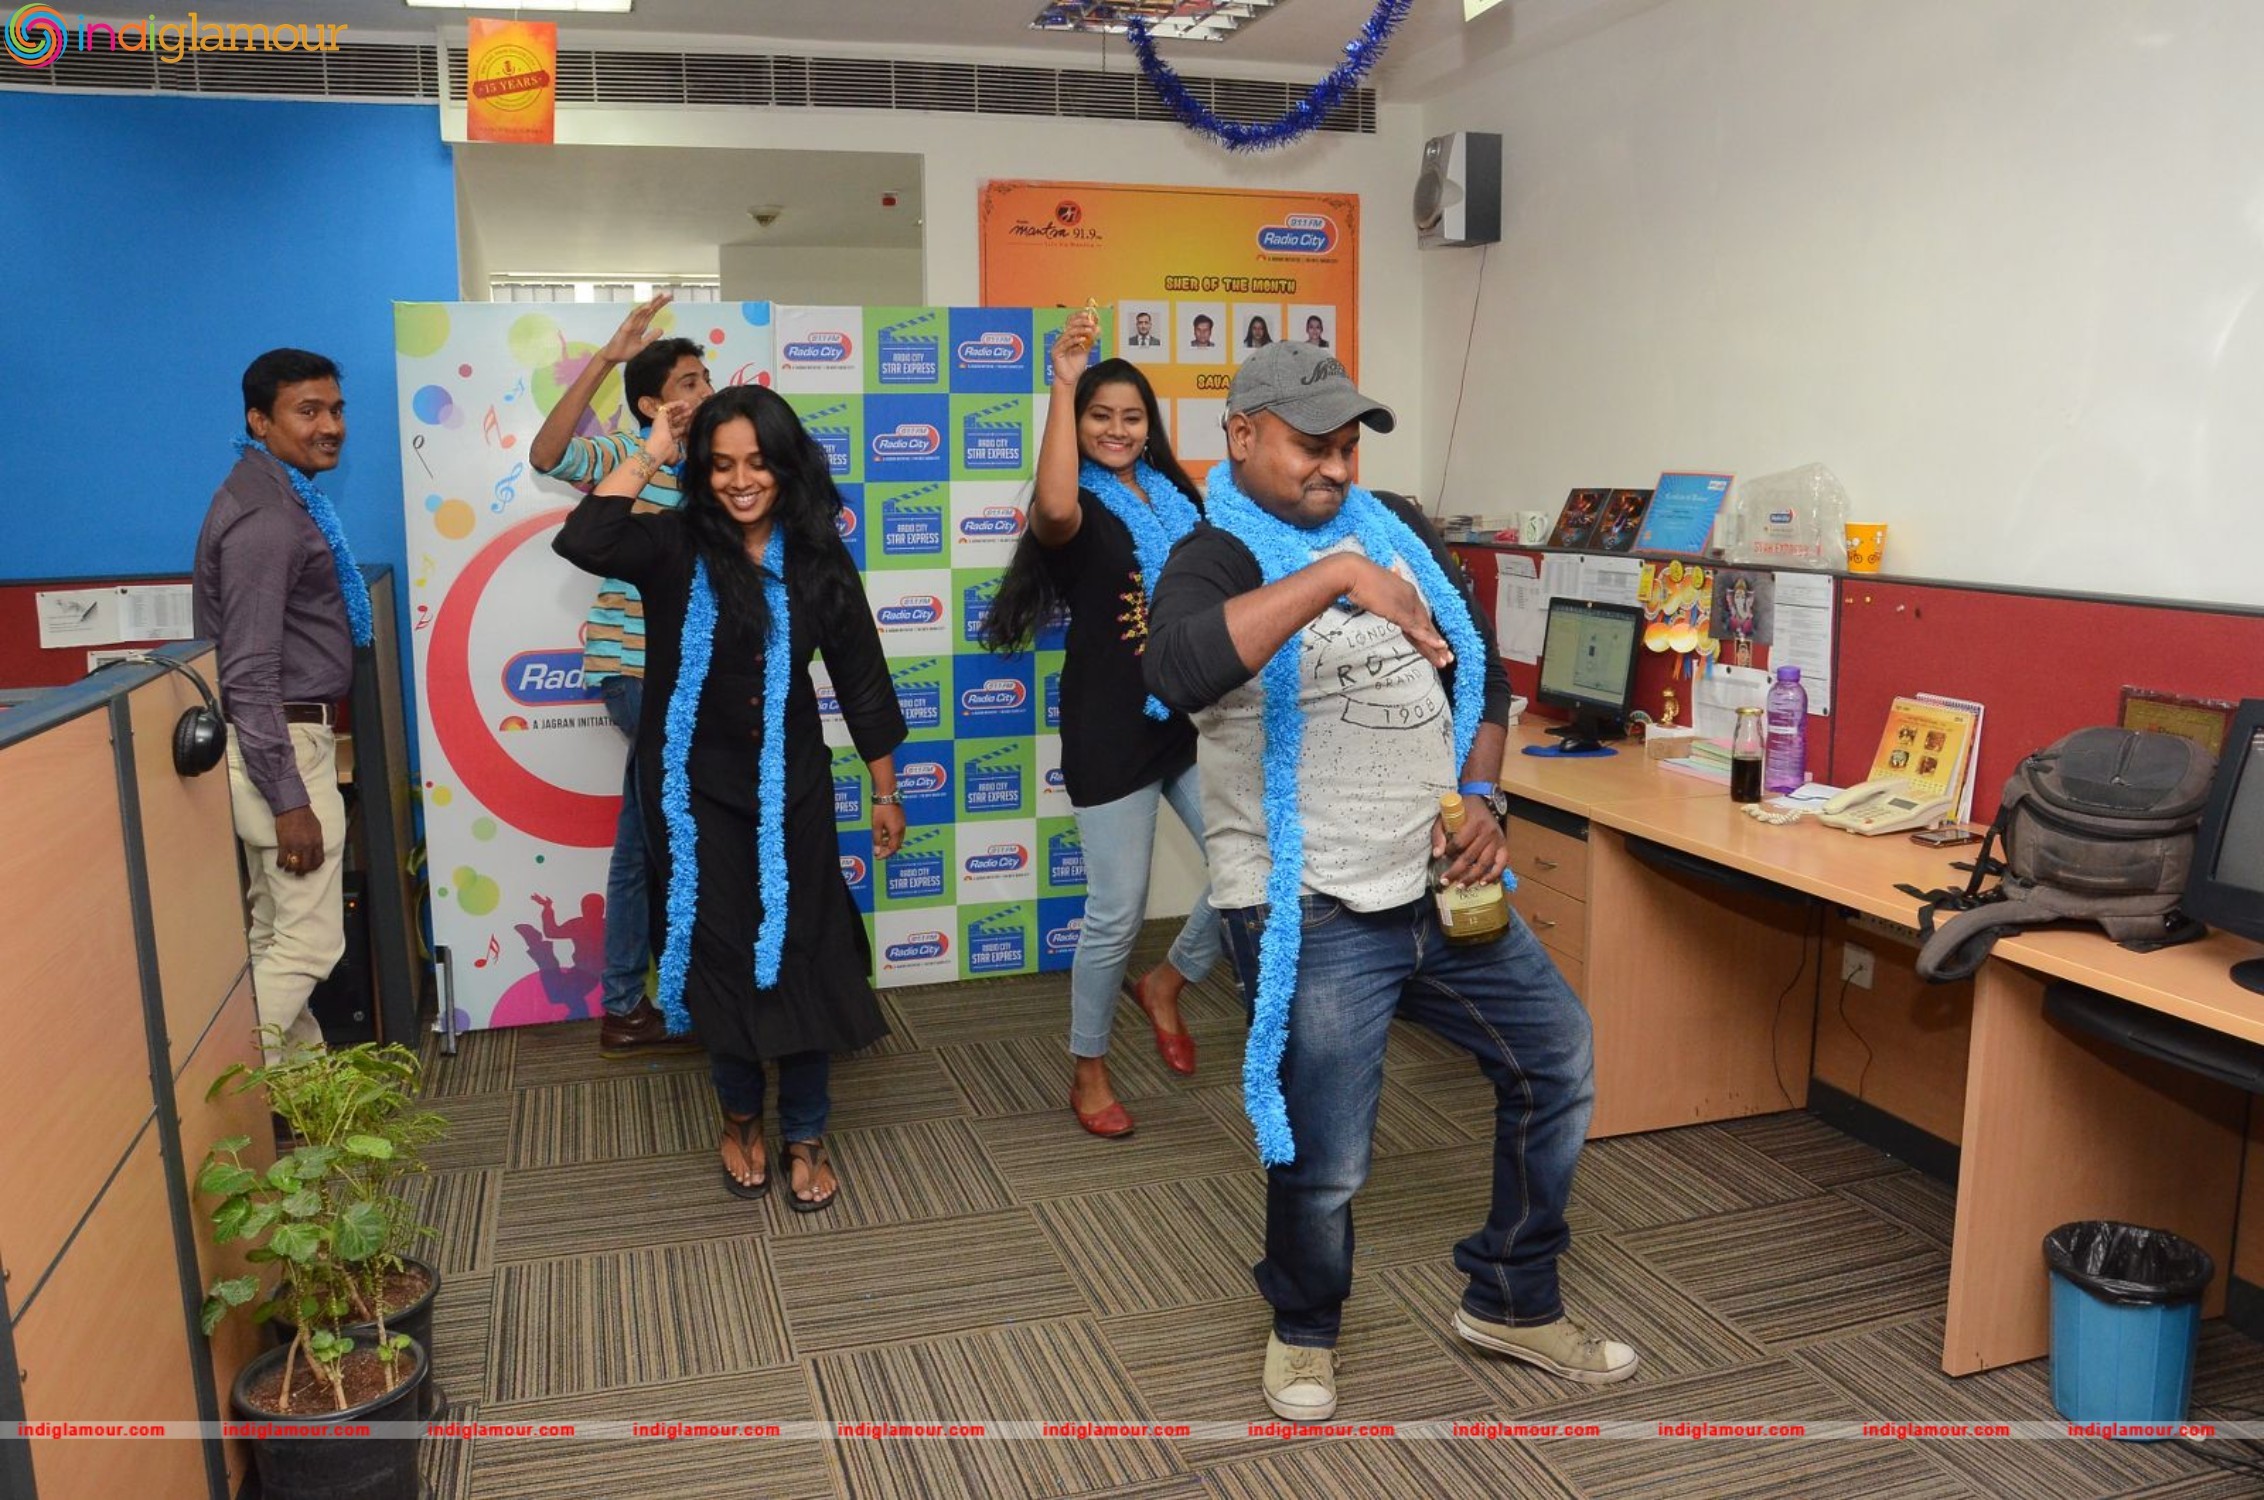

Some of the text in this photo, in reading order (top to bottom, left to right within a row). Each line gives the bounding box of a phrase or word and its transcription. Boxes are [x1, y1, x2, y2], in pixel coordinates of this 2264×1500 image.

[484, 76, 538, 94] 15 YEARS
[1073, 228, 1096, 239] 91.9
[1264, 232, 1326, 252] Radio City
[1165, 275, 1296, 294] SHER OF THE MONTH
[788, 346, 843, 360] Radio City
[912, 353, 924, 362] CITY
[964, 347, 1014, 360] Radio City
[882, 363, 936, 375] STAR EXPRESS
[879, 439, 930, 452] Radio City
[996, 438, 1008, 448] CITY
[967, 448, 1020, 460] STAR EXPRESS
[915, 523, 929, 533] CITY
[964, 520, 1016, 534] Radio City
[886, 532, 940, 545] STAR EXPRESS
[881, 608, 934, 622] Radio City
[518, 662, 587, 691] Rad
[913, 698, 926, 707] CITY
[968, 693, 1017, 705] Radio City
[905, 707, 938, 720] EXPRESS
[533, 720, 539, 730] A
[542, 717, 576, 730] JAGRAN
[916, 777, 937, 789] City
[995, 782, 1009, 791] CITY
[967, 790, 1019, 803] STAR EXPRESS
[969, 857, 1020, 869] Radio City
[917, 868, 930, 877] CITY
[1051, 866, 1071, 878] STAR
[889, 875, 941, 890] STAR EXPRESS
[888, 944, 941, 957] Radio City
[971, 950, 1022, 964] STAR EXPRESS
